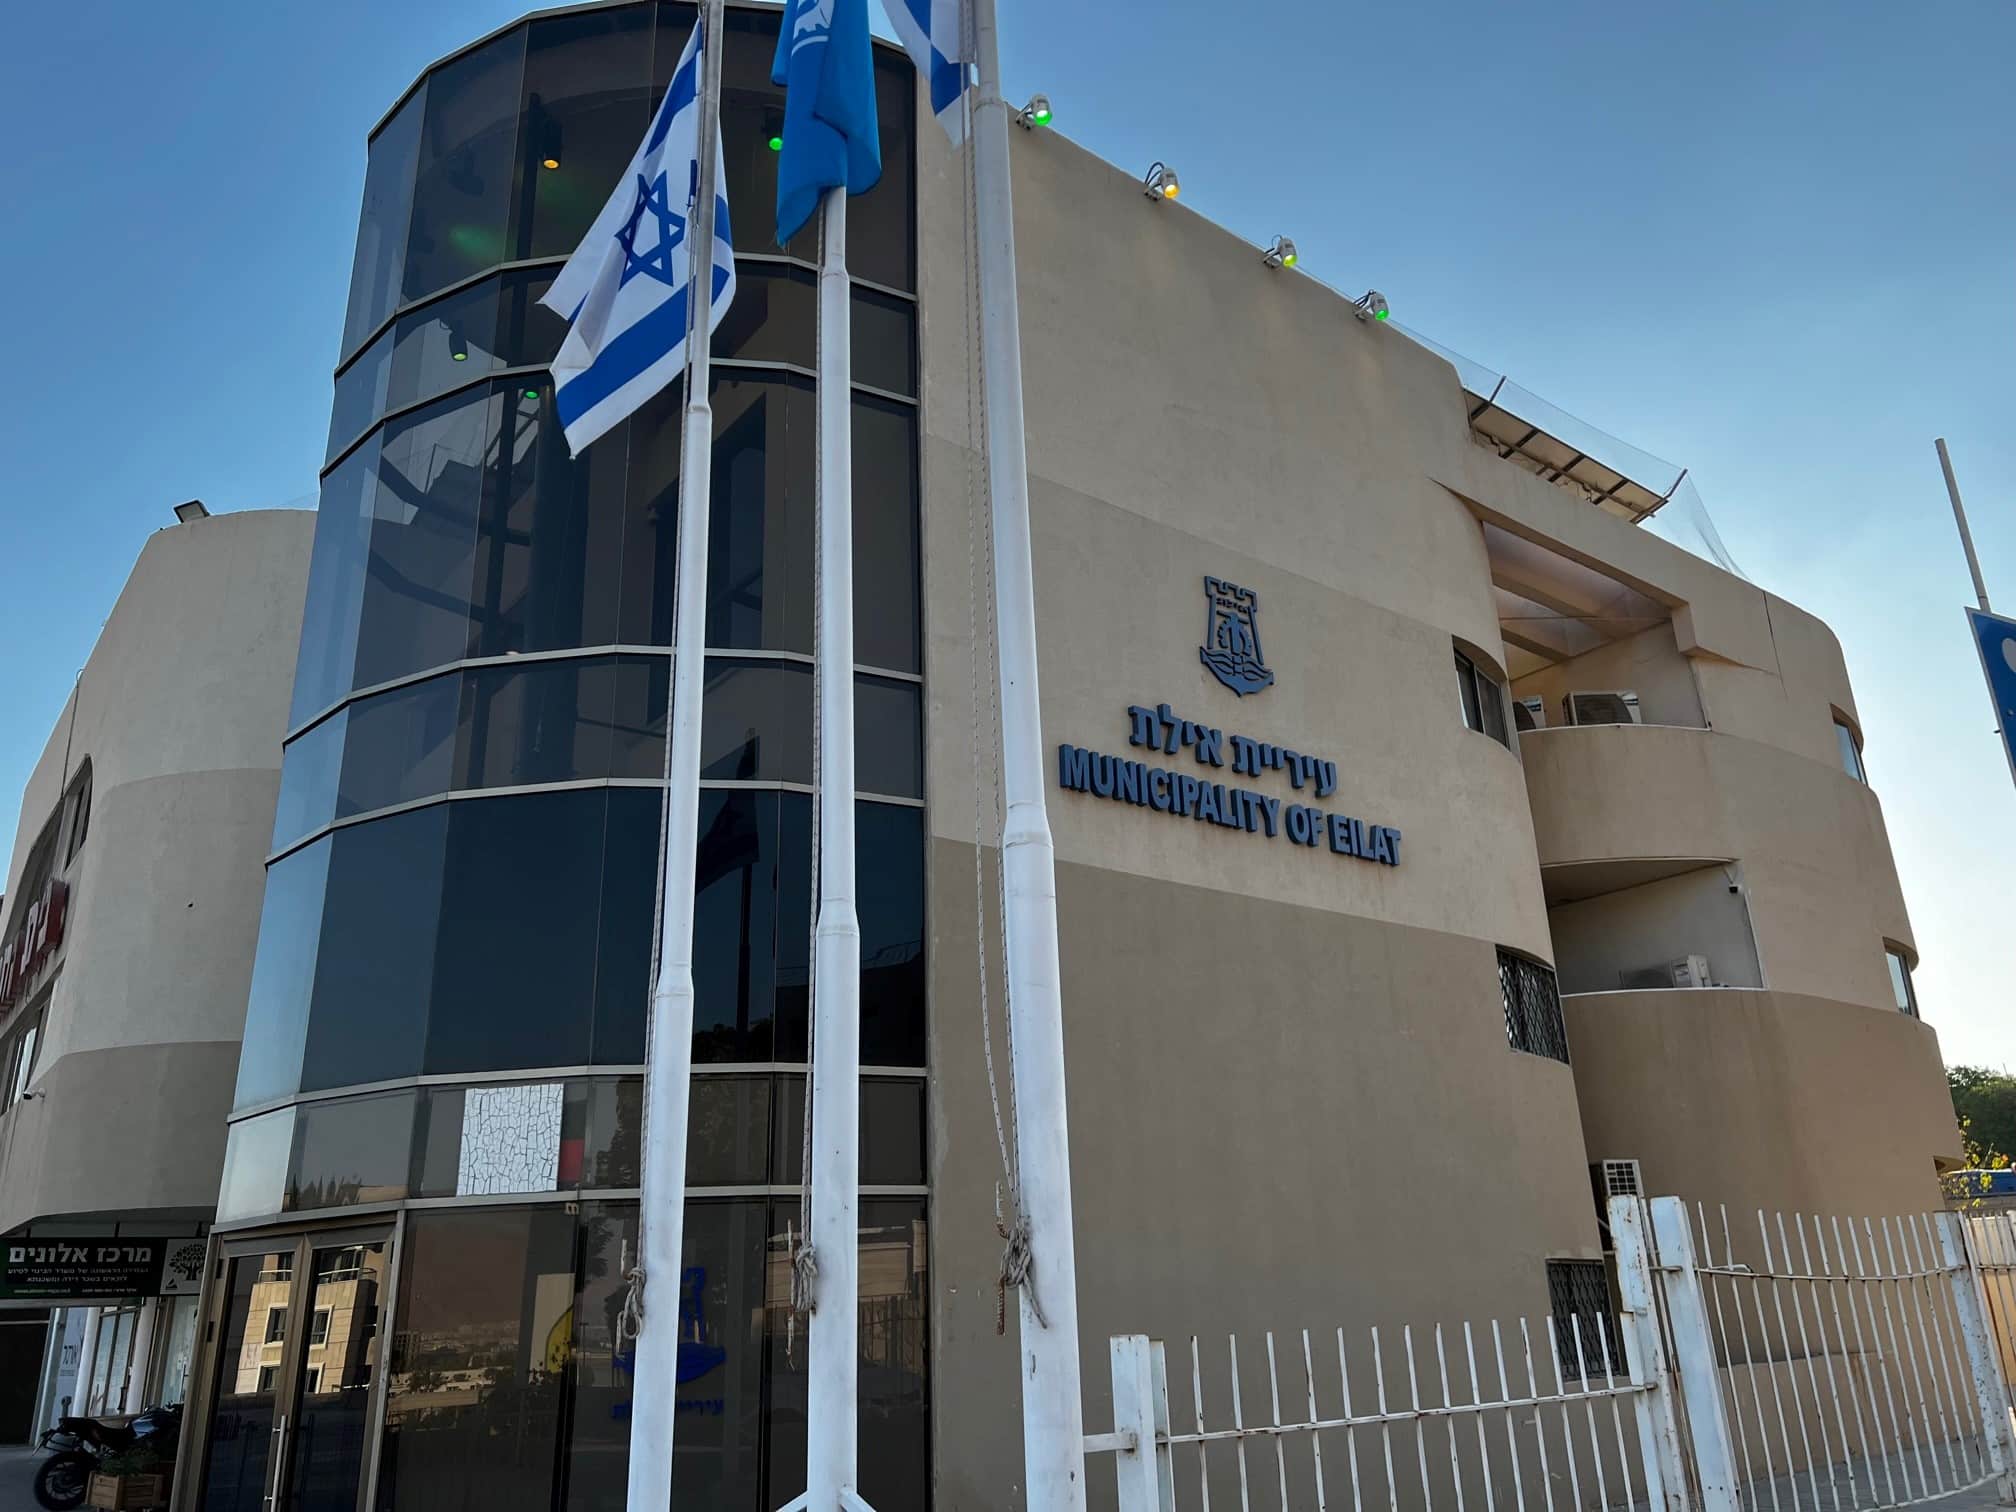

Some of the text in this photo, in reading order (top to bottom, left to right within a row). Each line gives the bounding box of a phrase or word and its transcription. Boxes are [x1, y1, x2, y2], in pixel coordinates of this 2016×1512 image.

[1127, 703, 1337, 798] עיריית אילת
[1058, 744, 1401, 866] MUNICIPALITY OF EILAT
[9, 1243, 152, 1263] מרכז אלונים
